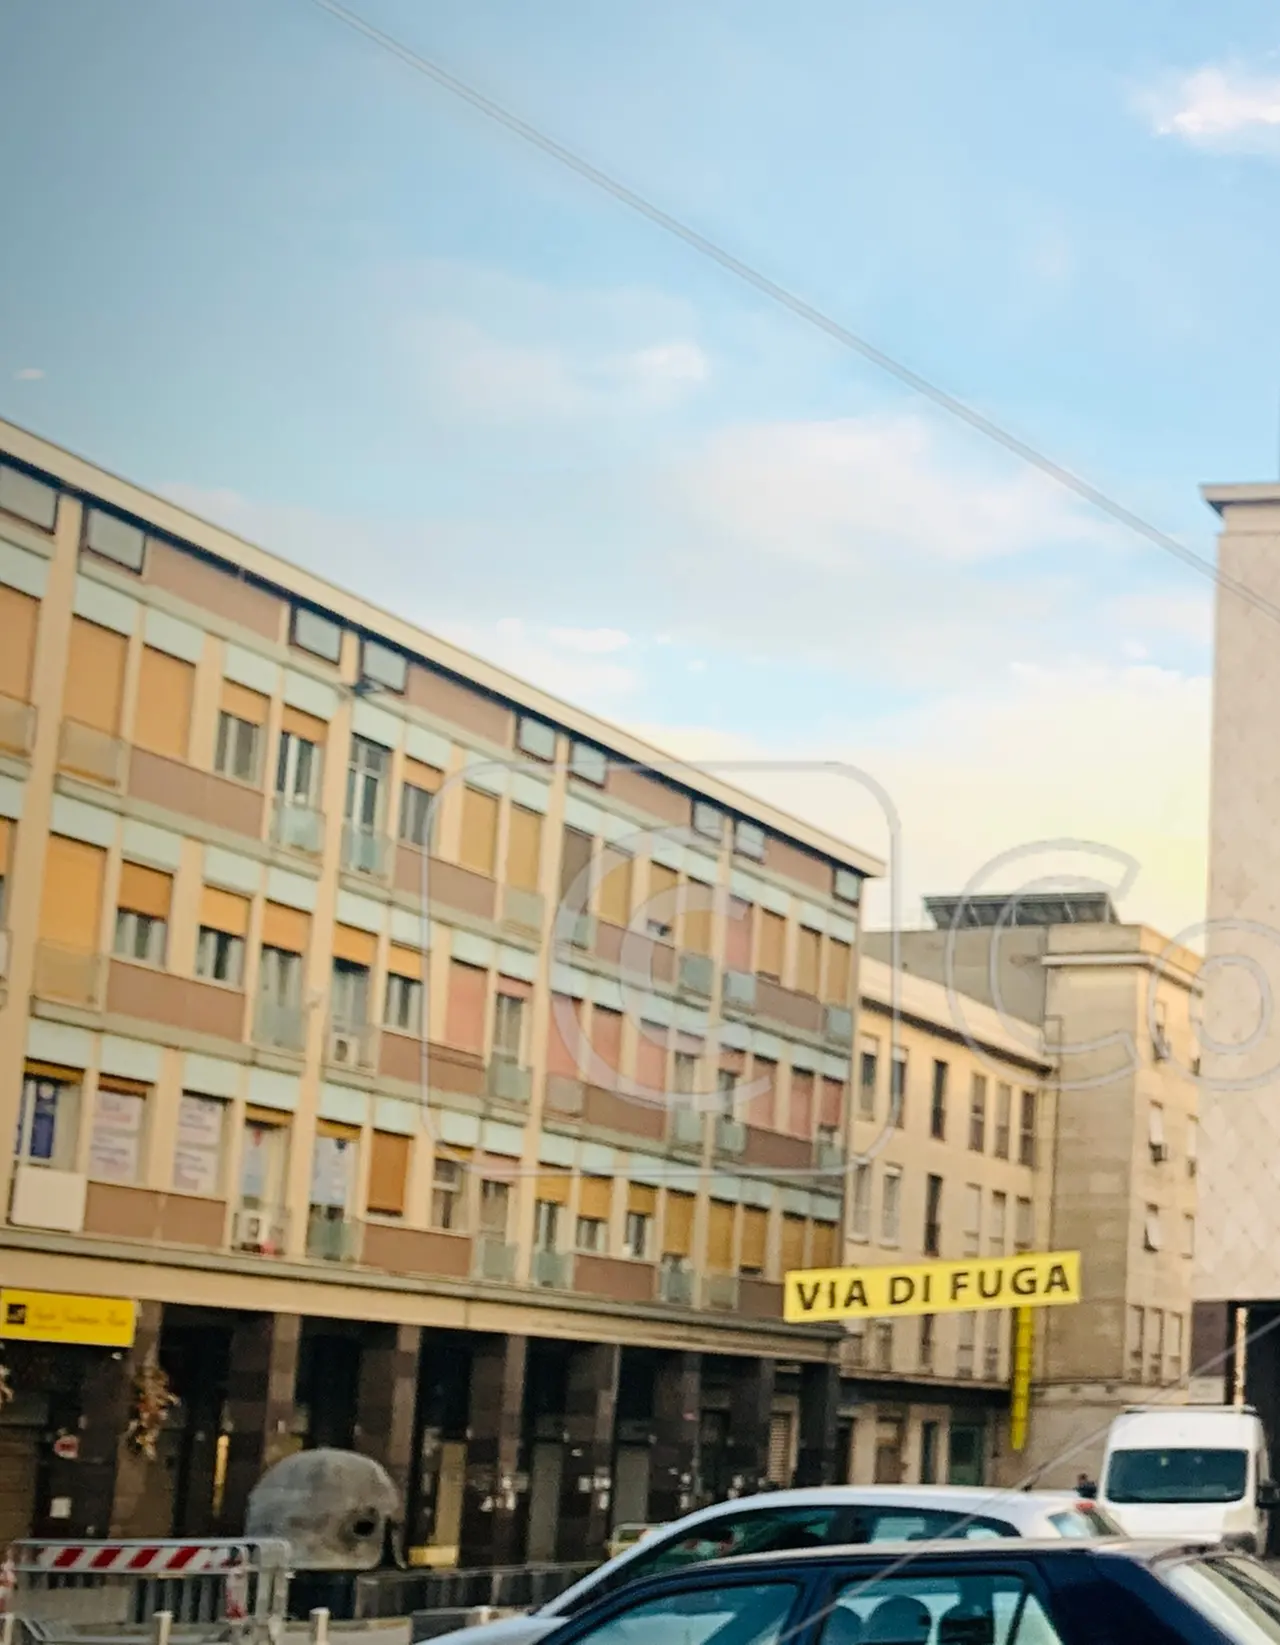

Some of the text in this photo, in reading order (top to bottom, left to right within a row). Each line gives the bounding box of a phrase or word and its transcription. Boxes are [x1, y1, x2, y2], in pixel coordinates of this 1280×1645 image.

[796, 1264, 1071, 1310] VIA DI FUGA
